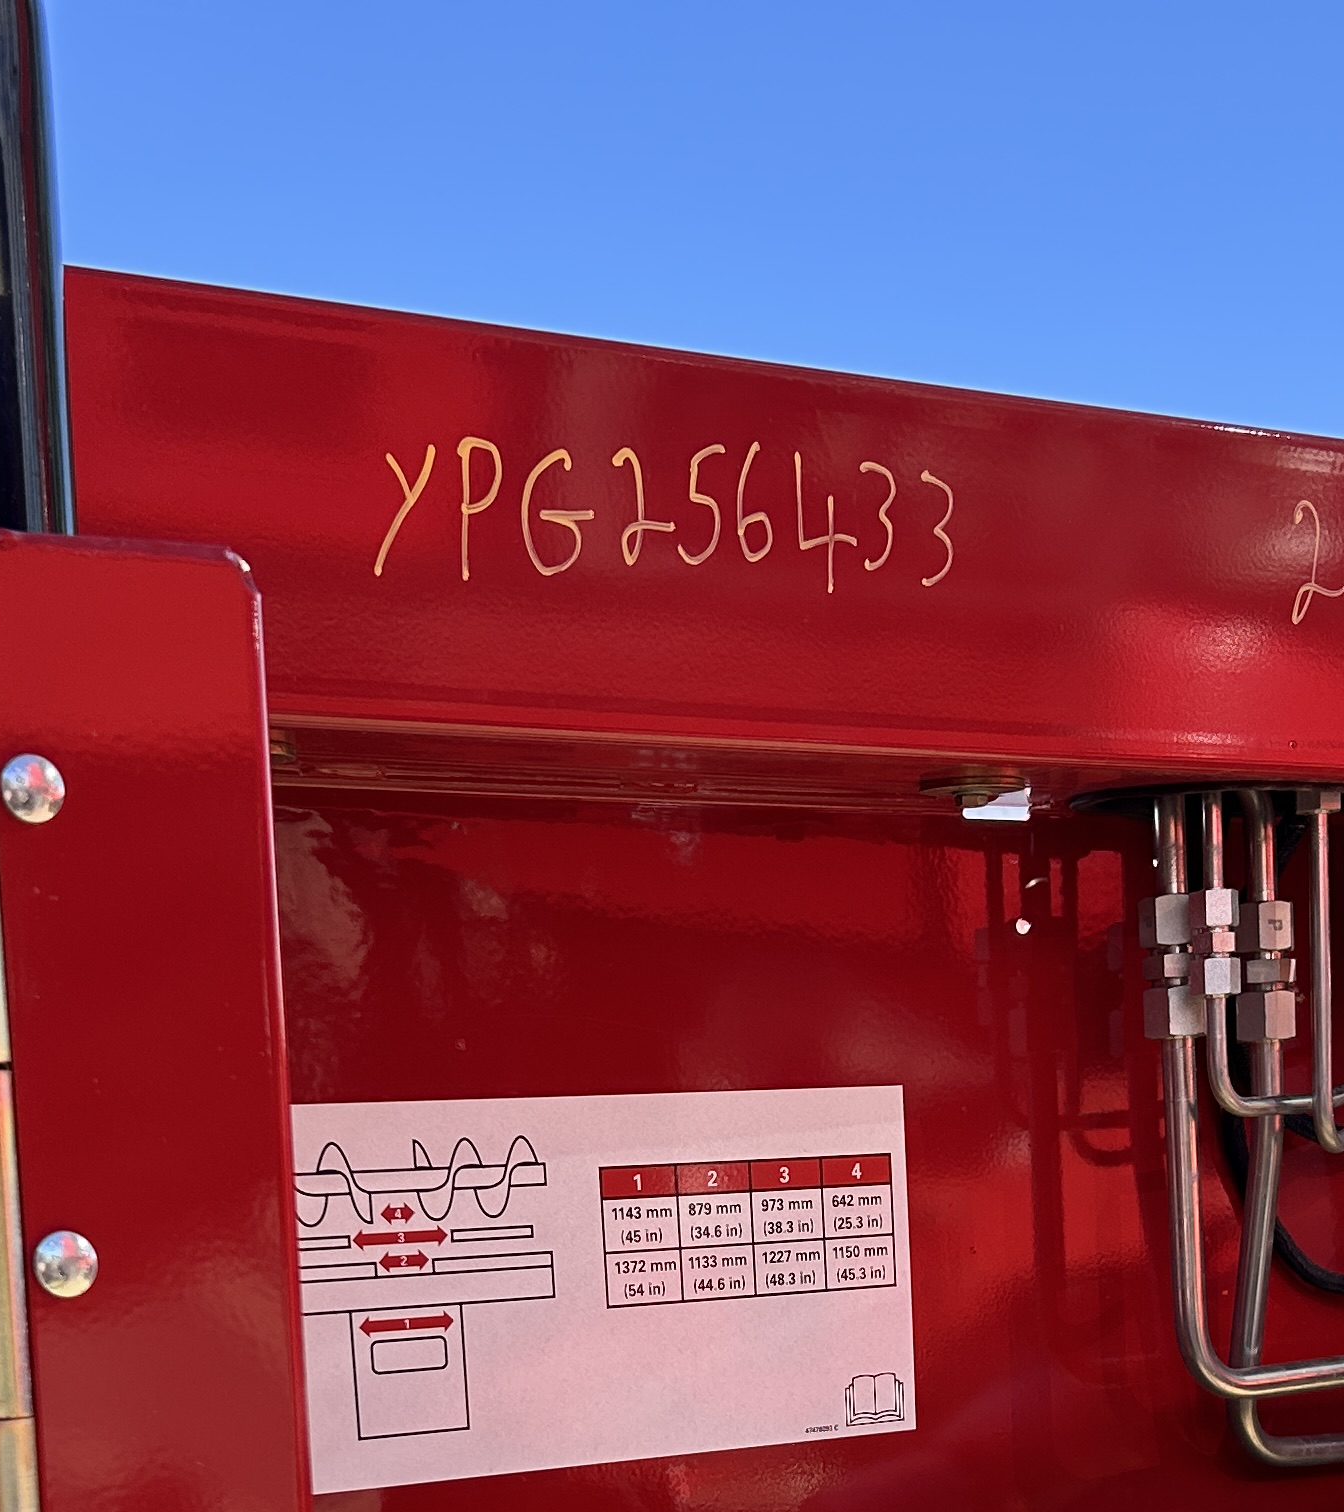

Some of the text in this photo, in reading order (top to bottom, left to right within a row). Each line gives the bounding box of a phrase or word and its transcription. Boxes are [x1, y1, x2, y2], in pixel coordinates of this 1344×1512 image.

[708, 1171, 718, 1186] 2
[780, 1167, 789, 1183] 3
[852, 1163, 861, 1179] 4
[634, 1174, 641, 1190] 1
[762, 1199, 813, 1211] 973 mm
[832, 1195, 881, 1207] 642 mm
[394, 1208, 402, 1219] 4
[612, 1207, 672, 1220] 1143 mm
[689, 1203, 741, 1216] 879 mm
[764, 1219, 813, 1236] (38.3 in)
[834, 1214, 882, 1232] (25.3 in)
[397, 1232, 405, 1243] 3
[621, 1228, 662, 1245] (45 in)
[691, 1223, 742, 1241] (34.6 in)
[762, 1250, 820, 1264] 1227 mm
[833, 1245, 888, 1259] 1150 mm
[399, 1255, 408, 1267] 2
[615, 1260, 676, 1274] 1372 mm
[689, 1255, 747, 1269] 1133 mm
[766, 1270, 815, 1289] (48.3 in)
[837, 1265, 885, 1283] (45.3 in)
[624, 1281, 665, 1299] (54 in)
[694, 1275, 745, 1294] (44.6 in)
